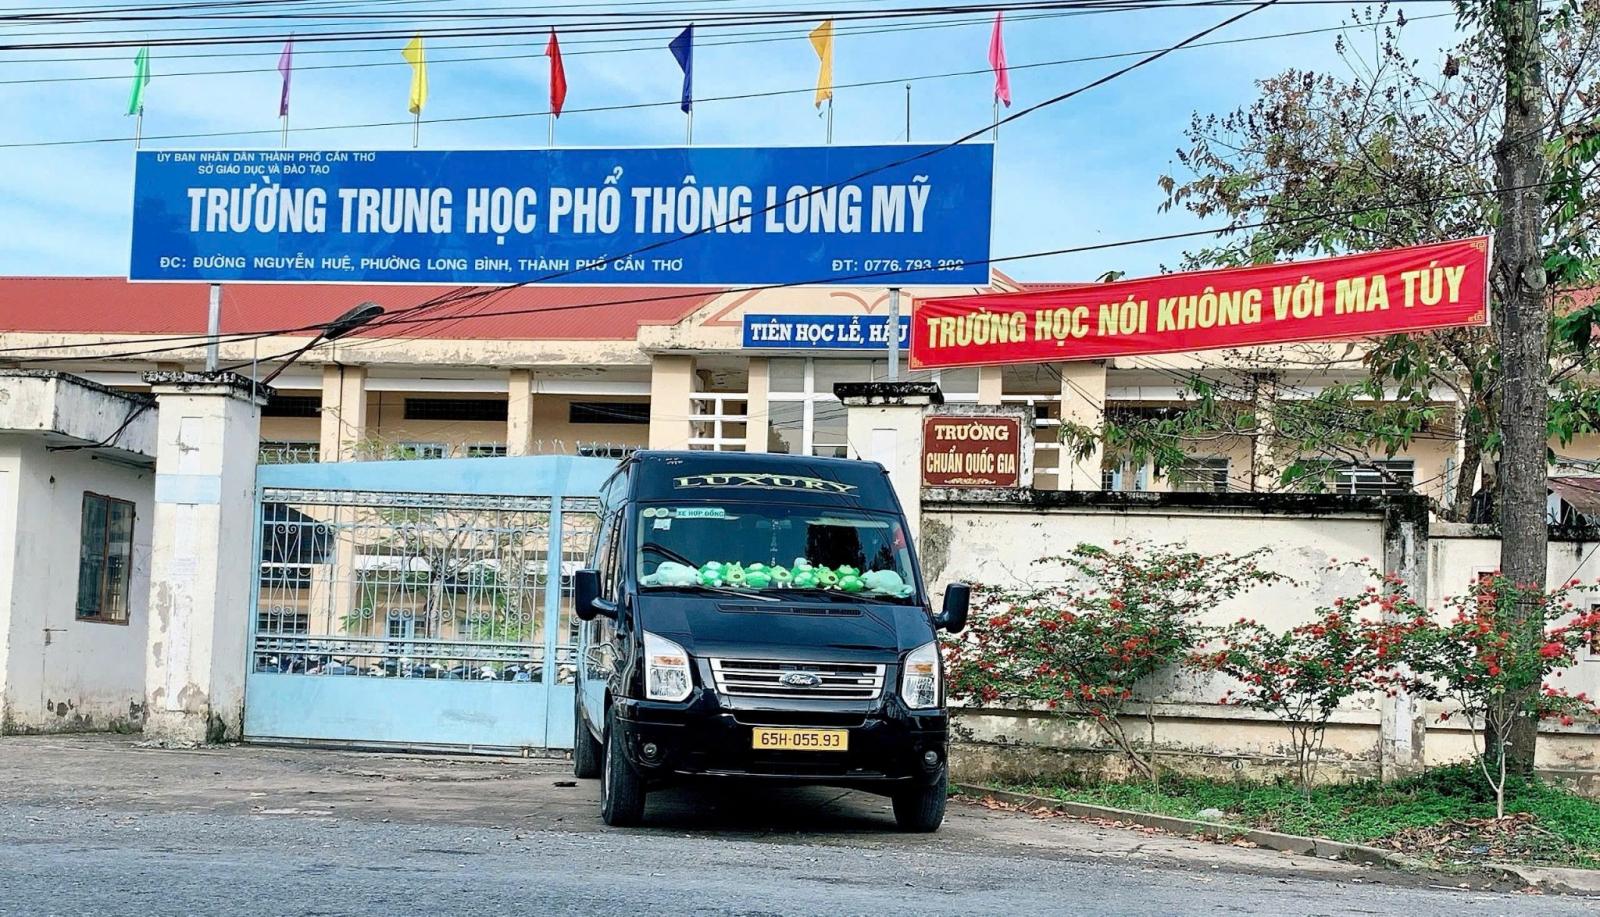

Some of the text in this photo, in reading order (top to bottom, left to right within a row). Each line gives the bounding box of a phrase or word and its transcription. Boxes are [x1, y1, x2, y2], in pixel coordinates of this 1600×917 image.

[174, 153, 196, 162] BAN
[200, 151, 230, 162] NHÂN
[233, 151, 255, 162] DÂN
[259, 150, 294, 162] THÀNH
[299, 150, 321, 162] PHỐ
[353, 151, 376, 162] THƠ
[198, 162, 330, 176] SỞ GIÁO DỤC VÀ ĐÀO TẠO
[187, 165, 931, 246] TRƯỜNG TRUNG HỌC PHỔ THÔNG LONG MỸ
[159, 253, 683, 272] ĐC: ĐƯỜNG NGUYỄN HUỆ, PHƯỜNG LONG BÌNH, THÀNH PHỐ CẦN THƠ
[831, 259, 858, 272] ĐT:
[927, 260, 1467, 349] TRƯỜNG HỌC NÓI KHÔNG VỚI MA TÚY
[750, 318, 793, 341] TIÊN
[795, 323, 835, 346] HỌC
[837, 315, 865, 345] LỄ,
[934, 420, 1010, 441] TRƯỜNG
[926, 444, 1016, 476] CHUẨN QUỐC GIA
[677, 474, 858, 494] LUXURY
[761, 732, 840, 747] 65H-055.93
